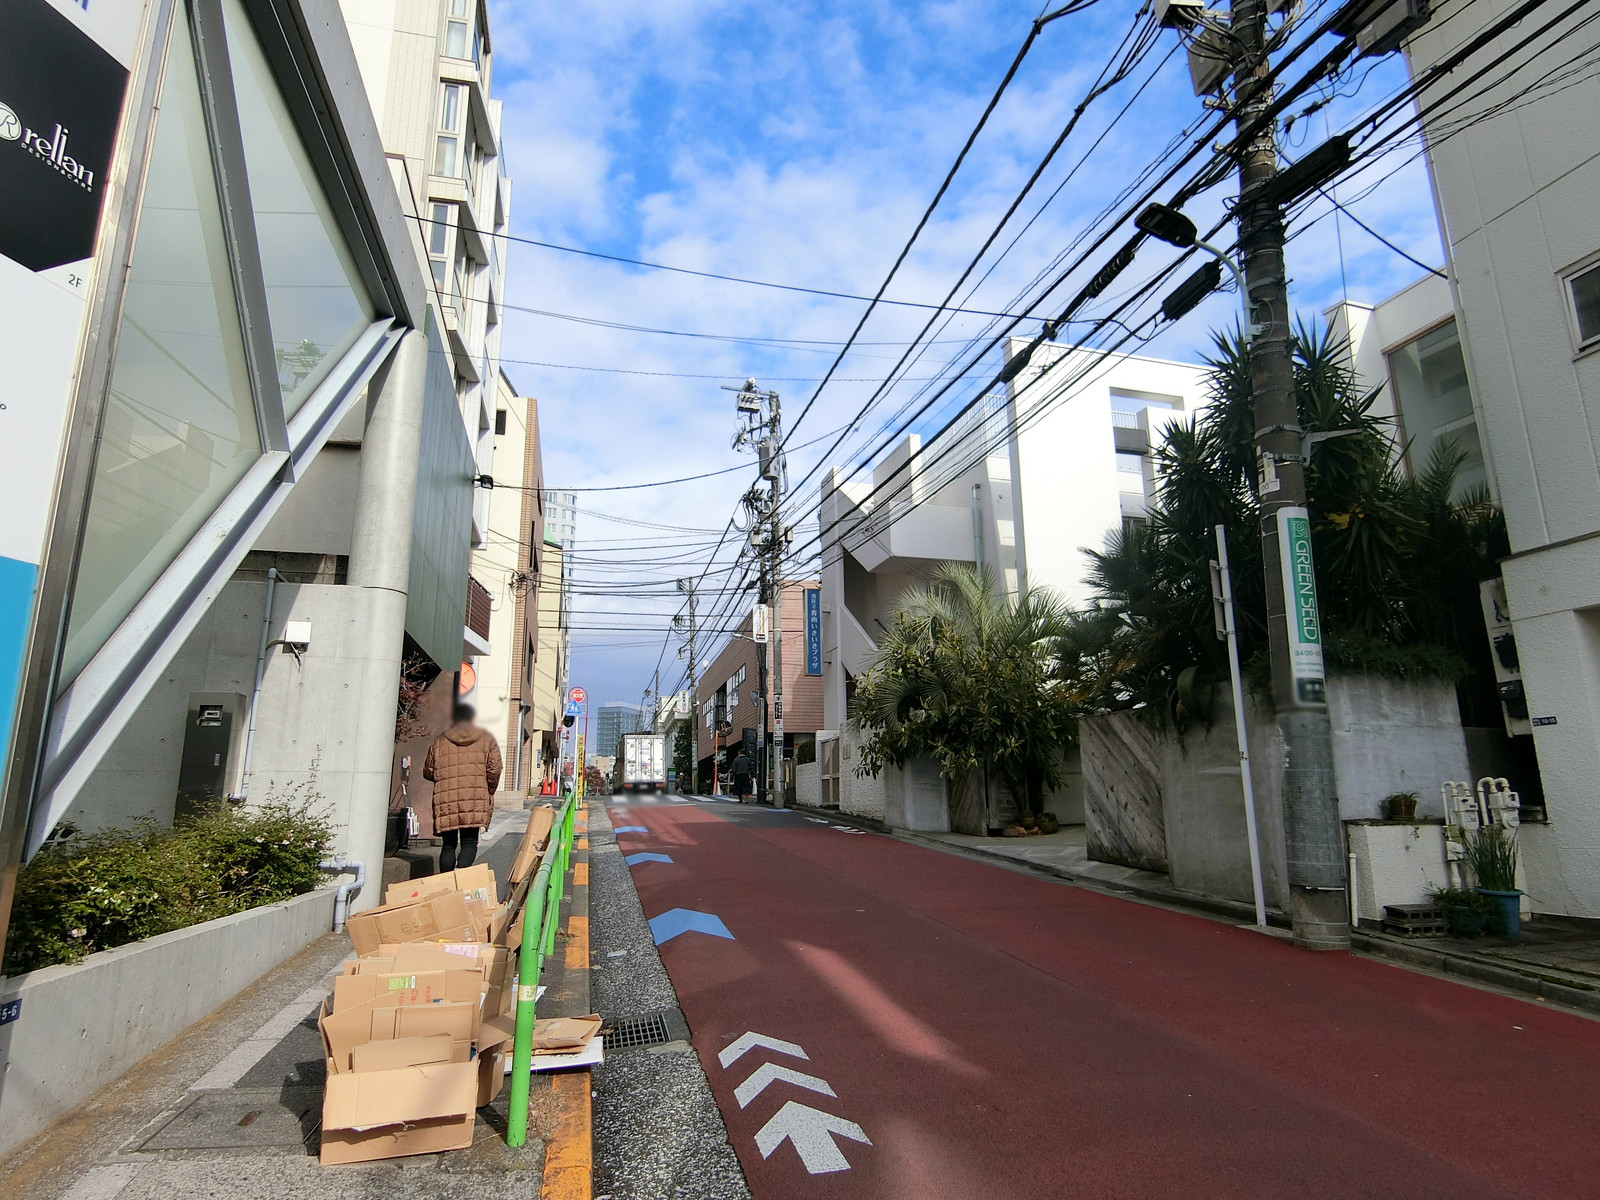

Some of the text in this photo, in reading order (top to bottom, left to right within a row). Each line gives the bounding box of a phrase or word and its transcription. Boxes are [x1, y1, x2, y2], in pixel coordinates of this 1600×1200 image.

[24, 122, 94, 187] relian
[68, 273, 83, 288] 2F
[1295, 540, 1314, 595] GREEN
[1301, 597, 1318, 640] SEED
